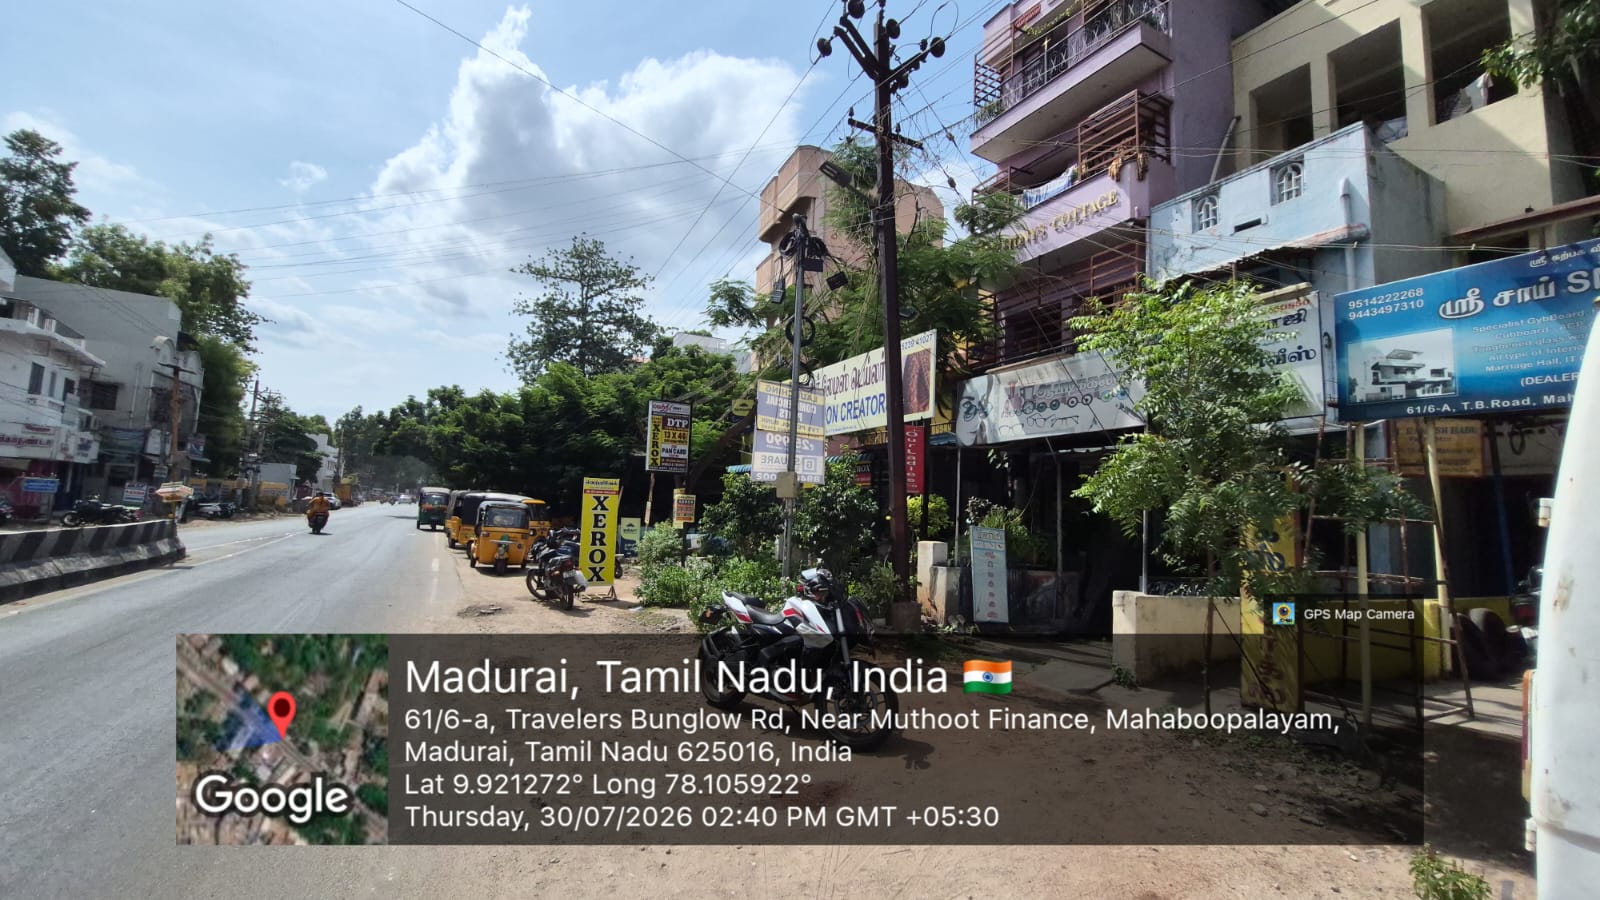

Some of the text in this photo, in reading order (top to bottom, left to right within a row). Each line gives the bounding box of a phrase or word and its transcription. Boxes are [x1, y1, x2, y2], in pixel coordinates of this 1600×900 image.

[1051, 189, 1118, 231] COTTAGE
[1348, 287, 1424, 310] 9514222268
[1439, 287, 1485, 319] ஸ்ரீ
[1493, 276, 1556, 308] சாய்
[1348, 299, 1425, 320] 9443497310
[1472, 319, 1525, 334] Specialist
[1485, 360, 1533, 374] Marriage
[840, 392, 887, 422] CREATOR
[1406, 402, 1456, 416] 61/6-A,
[1461, 396, 1537, 411] T.B.Road,
[667, 418, 688, 428] DTP
[651, 423, 661, 466] XEROX
[588, 496, 609, 581] XEROX
